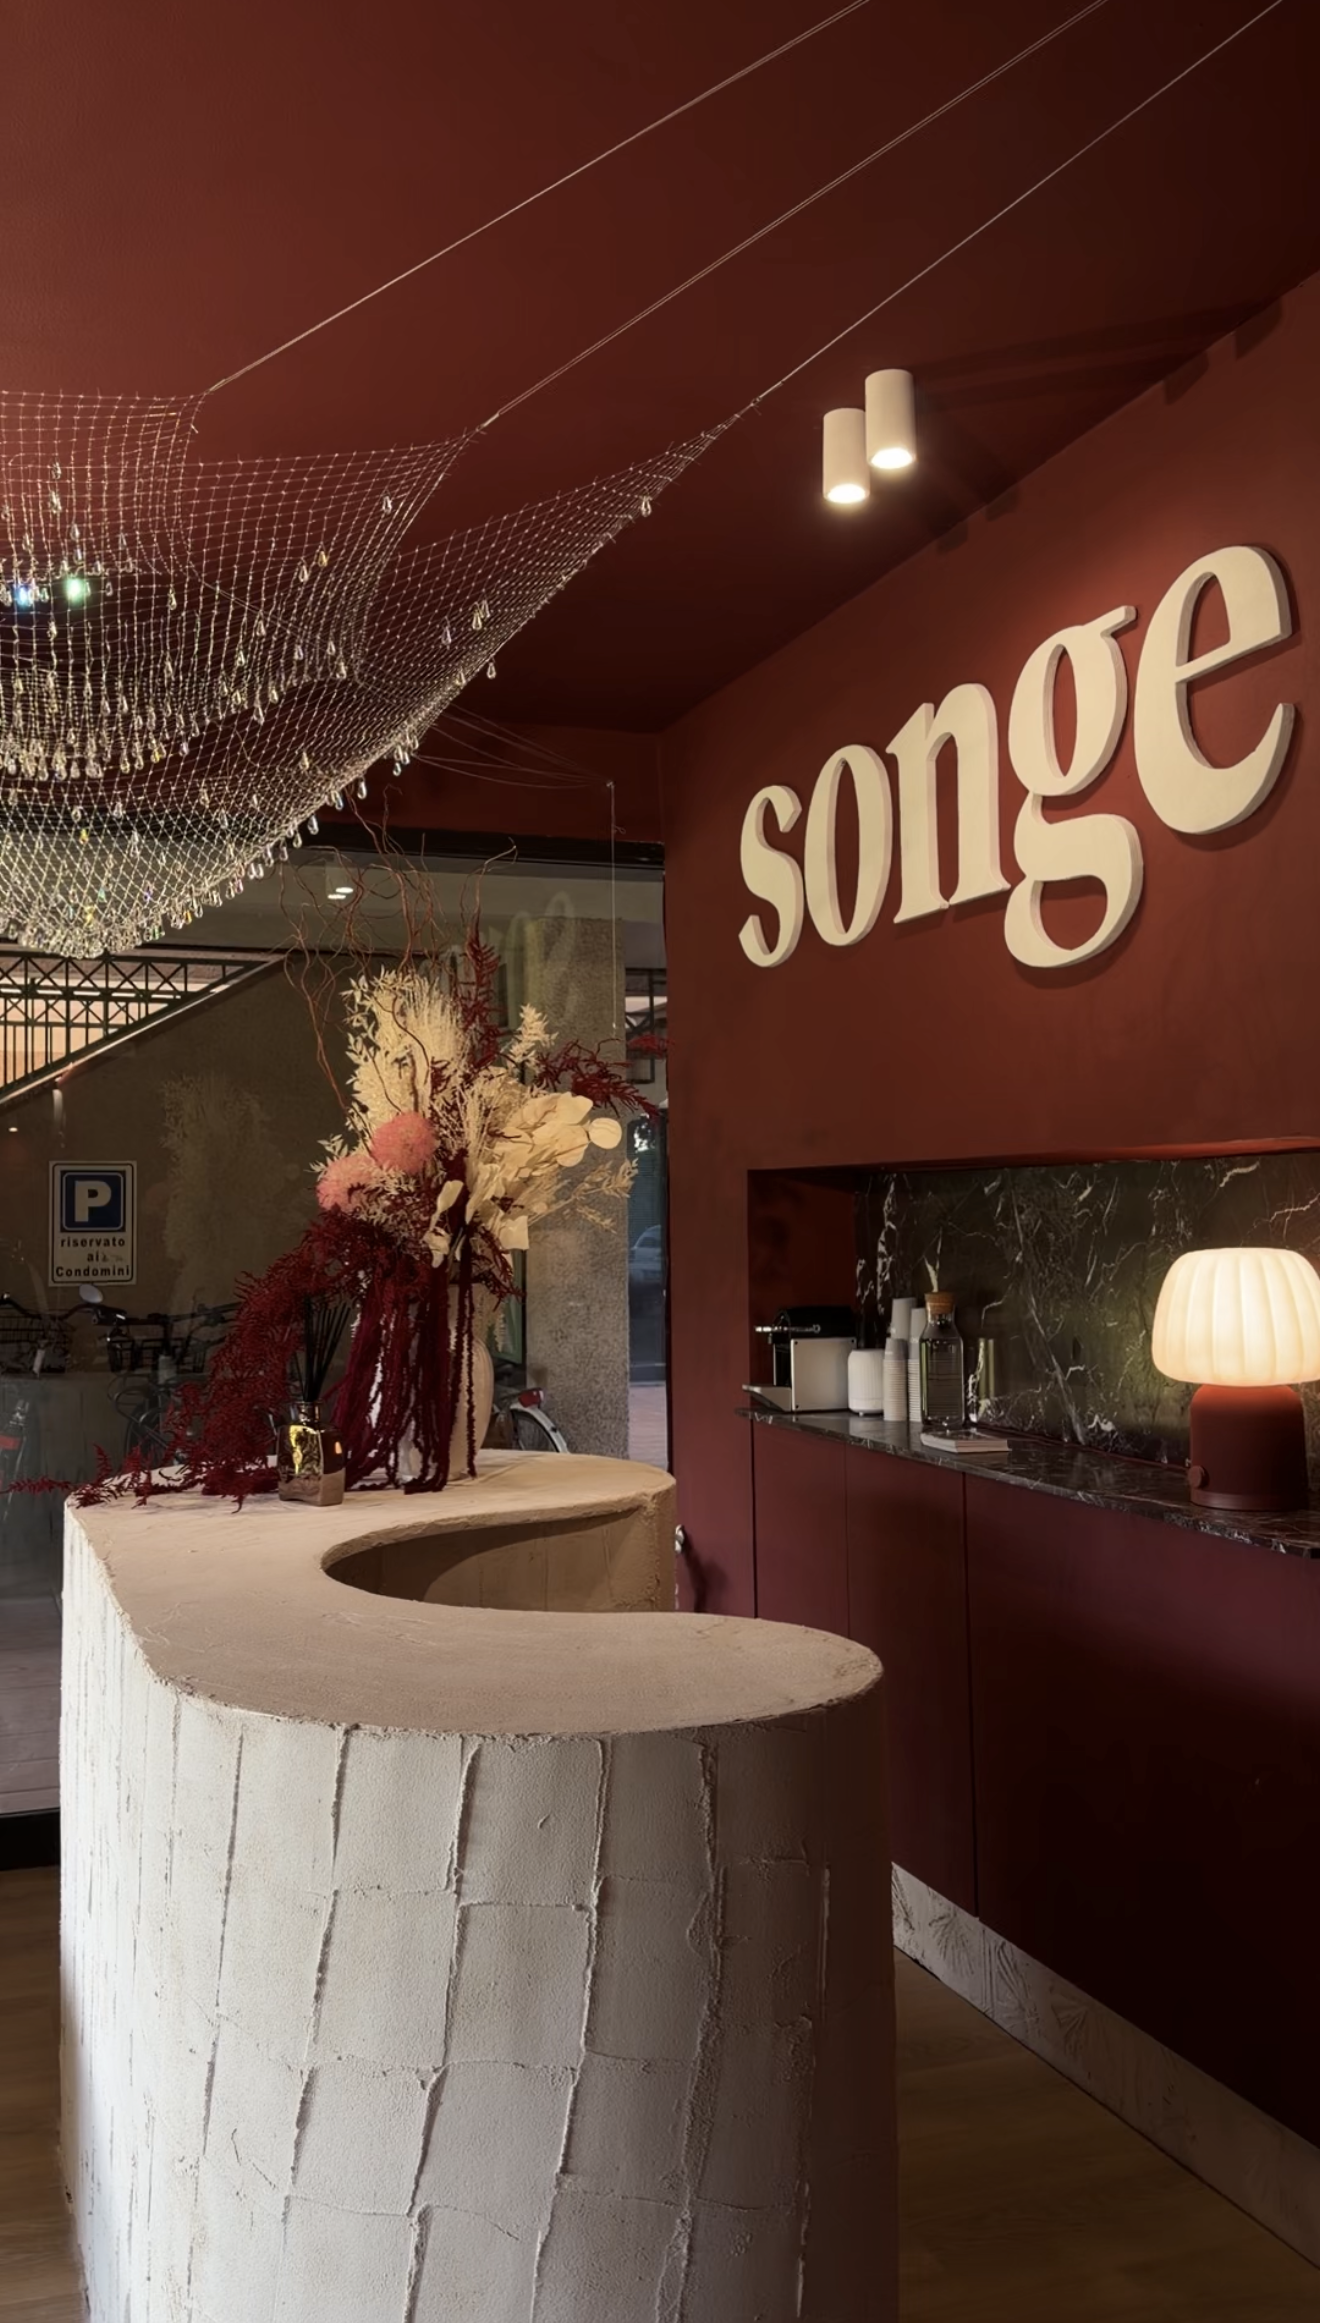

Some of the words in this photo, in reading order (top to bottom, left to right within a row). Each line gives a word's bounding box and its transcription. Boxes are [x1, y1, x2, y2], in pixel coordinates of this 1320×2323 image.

[738, 545, 1296, 968] songe
[74, 1180, 112, 1223] P
[60, 1237, 125, 1247] riservato
[56, 1265, 130, 1277] Condomini
